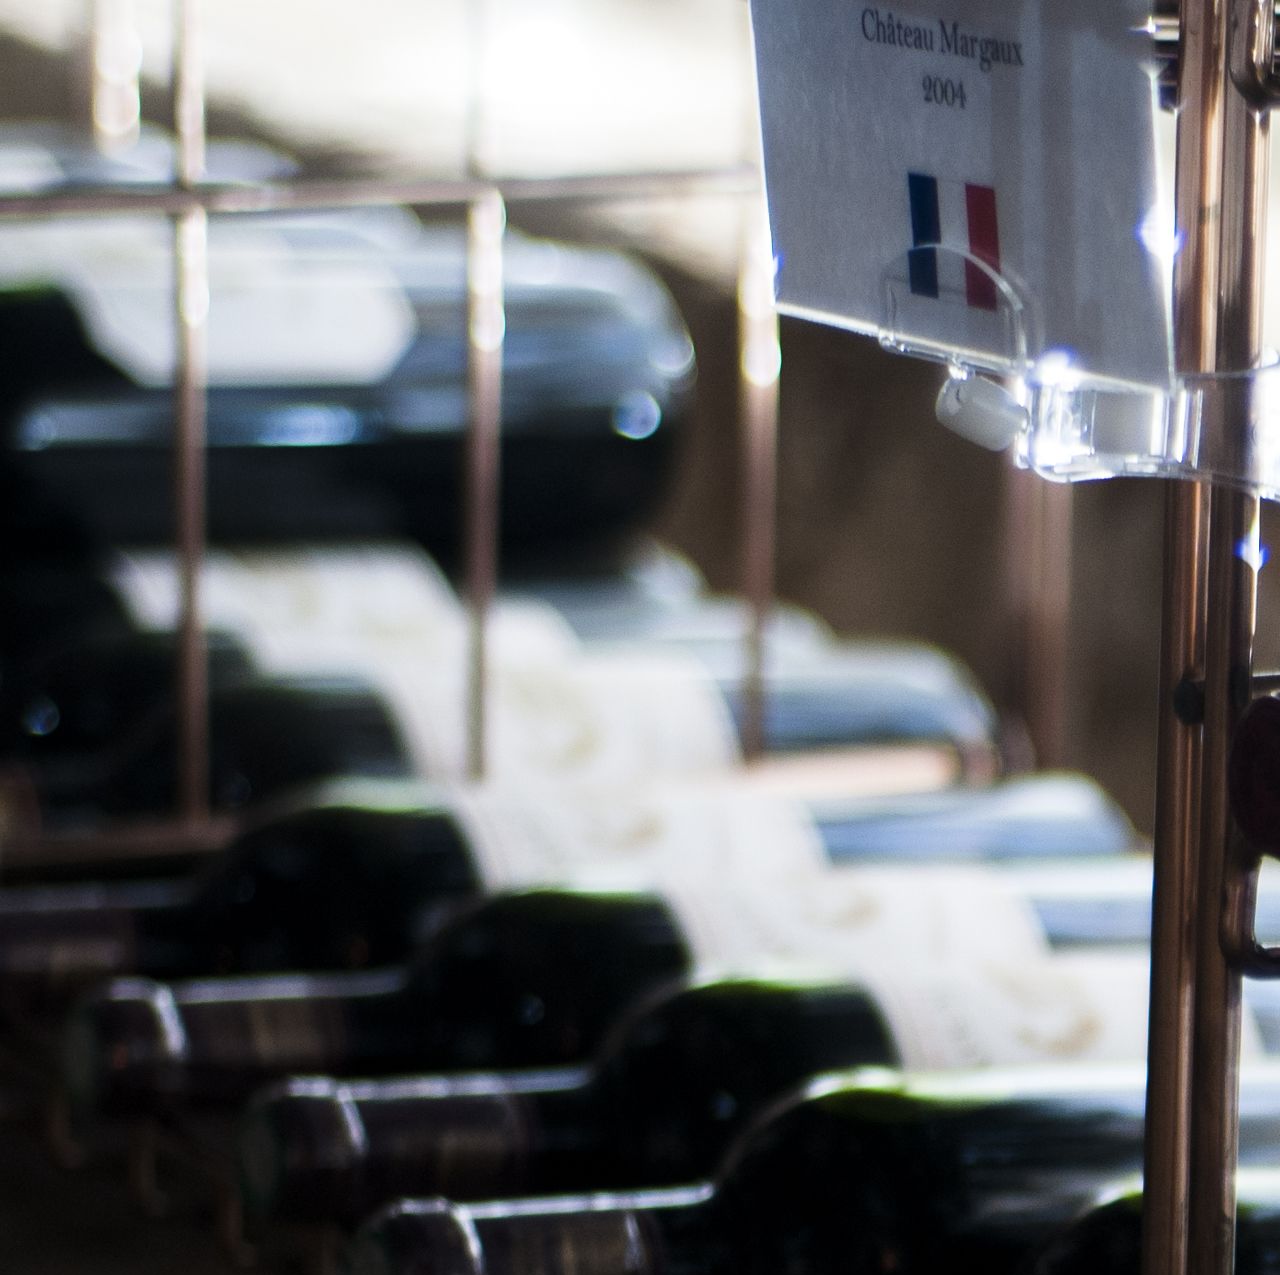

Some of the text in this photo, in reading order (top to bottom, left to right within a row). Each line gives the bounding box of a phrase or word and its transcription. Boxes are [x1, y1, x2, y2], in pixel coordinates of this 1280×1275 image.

[861, 8, 1024, 73] Château Margaux
[922, 75, 967, 110] 2004
